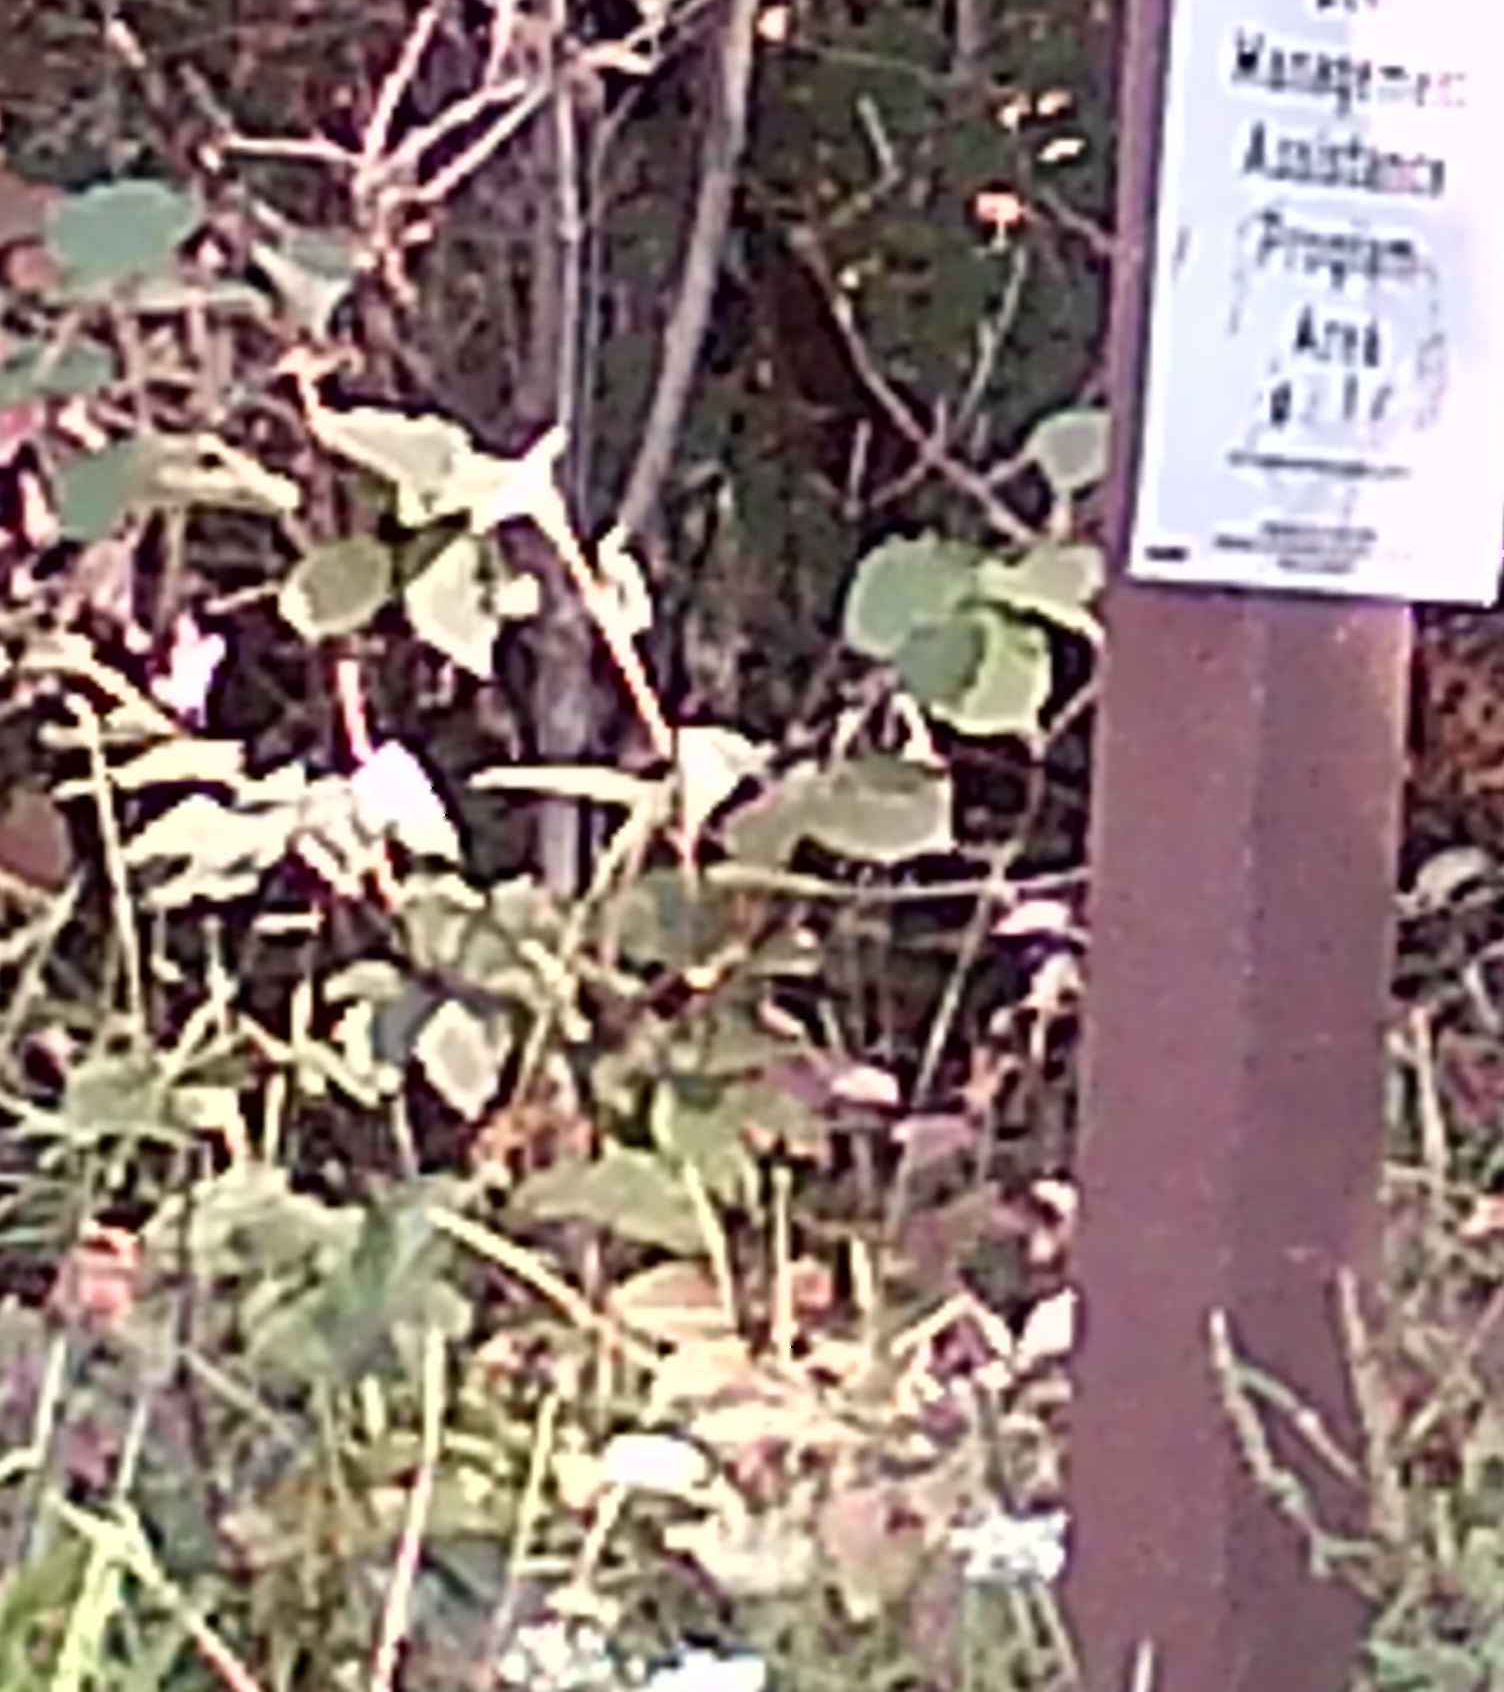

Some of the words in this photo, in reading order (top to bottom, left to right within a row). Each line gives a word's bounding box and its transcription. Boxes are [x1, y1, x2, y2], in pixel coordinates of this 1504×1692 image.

[1242, 121, 1446, 200] Assistance
[1256, 208, 1418, 292] Program
[1295, 306, 1380, 368] Area
